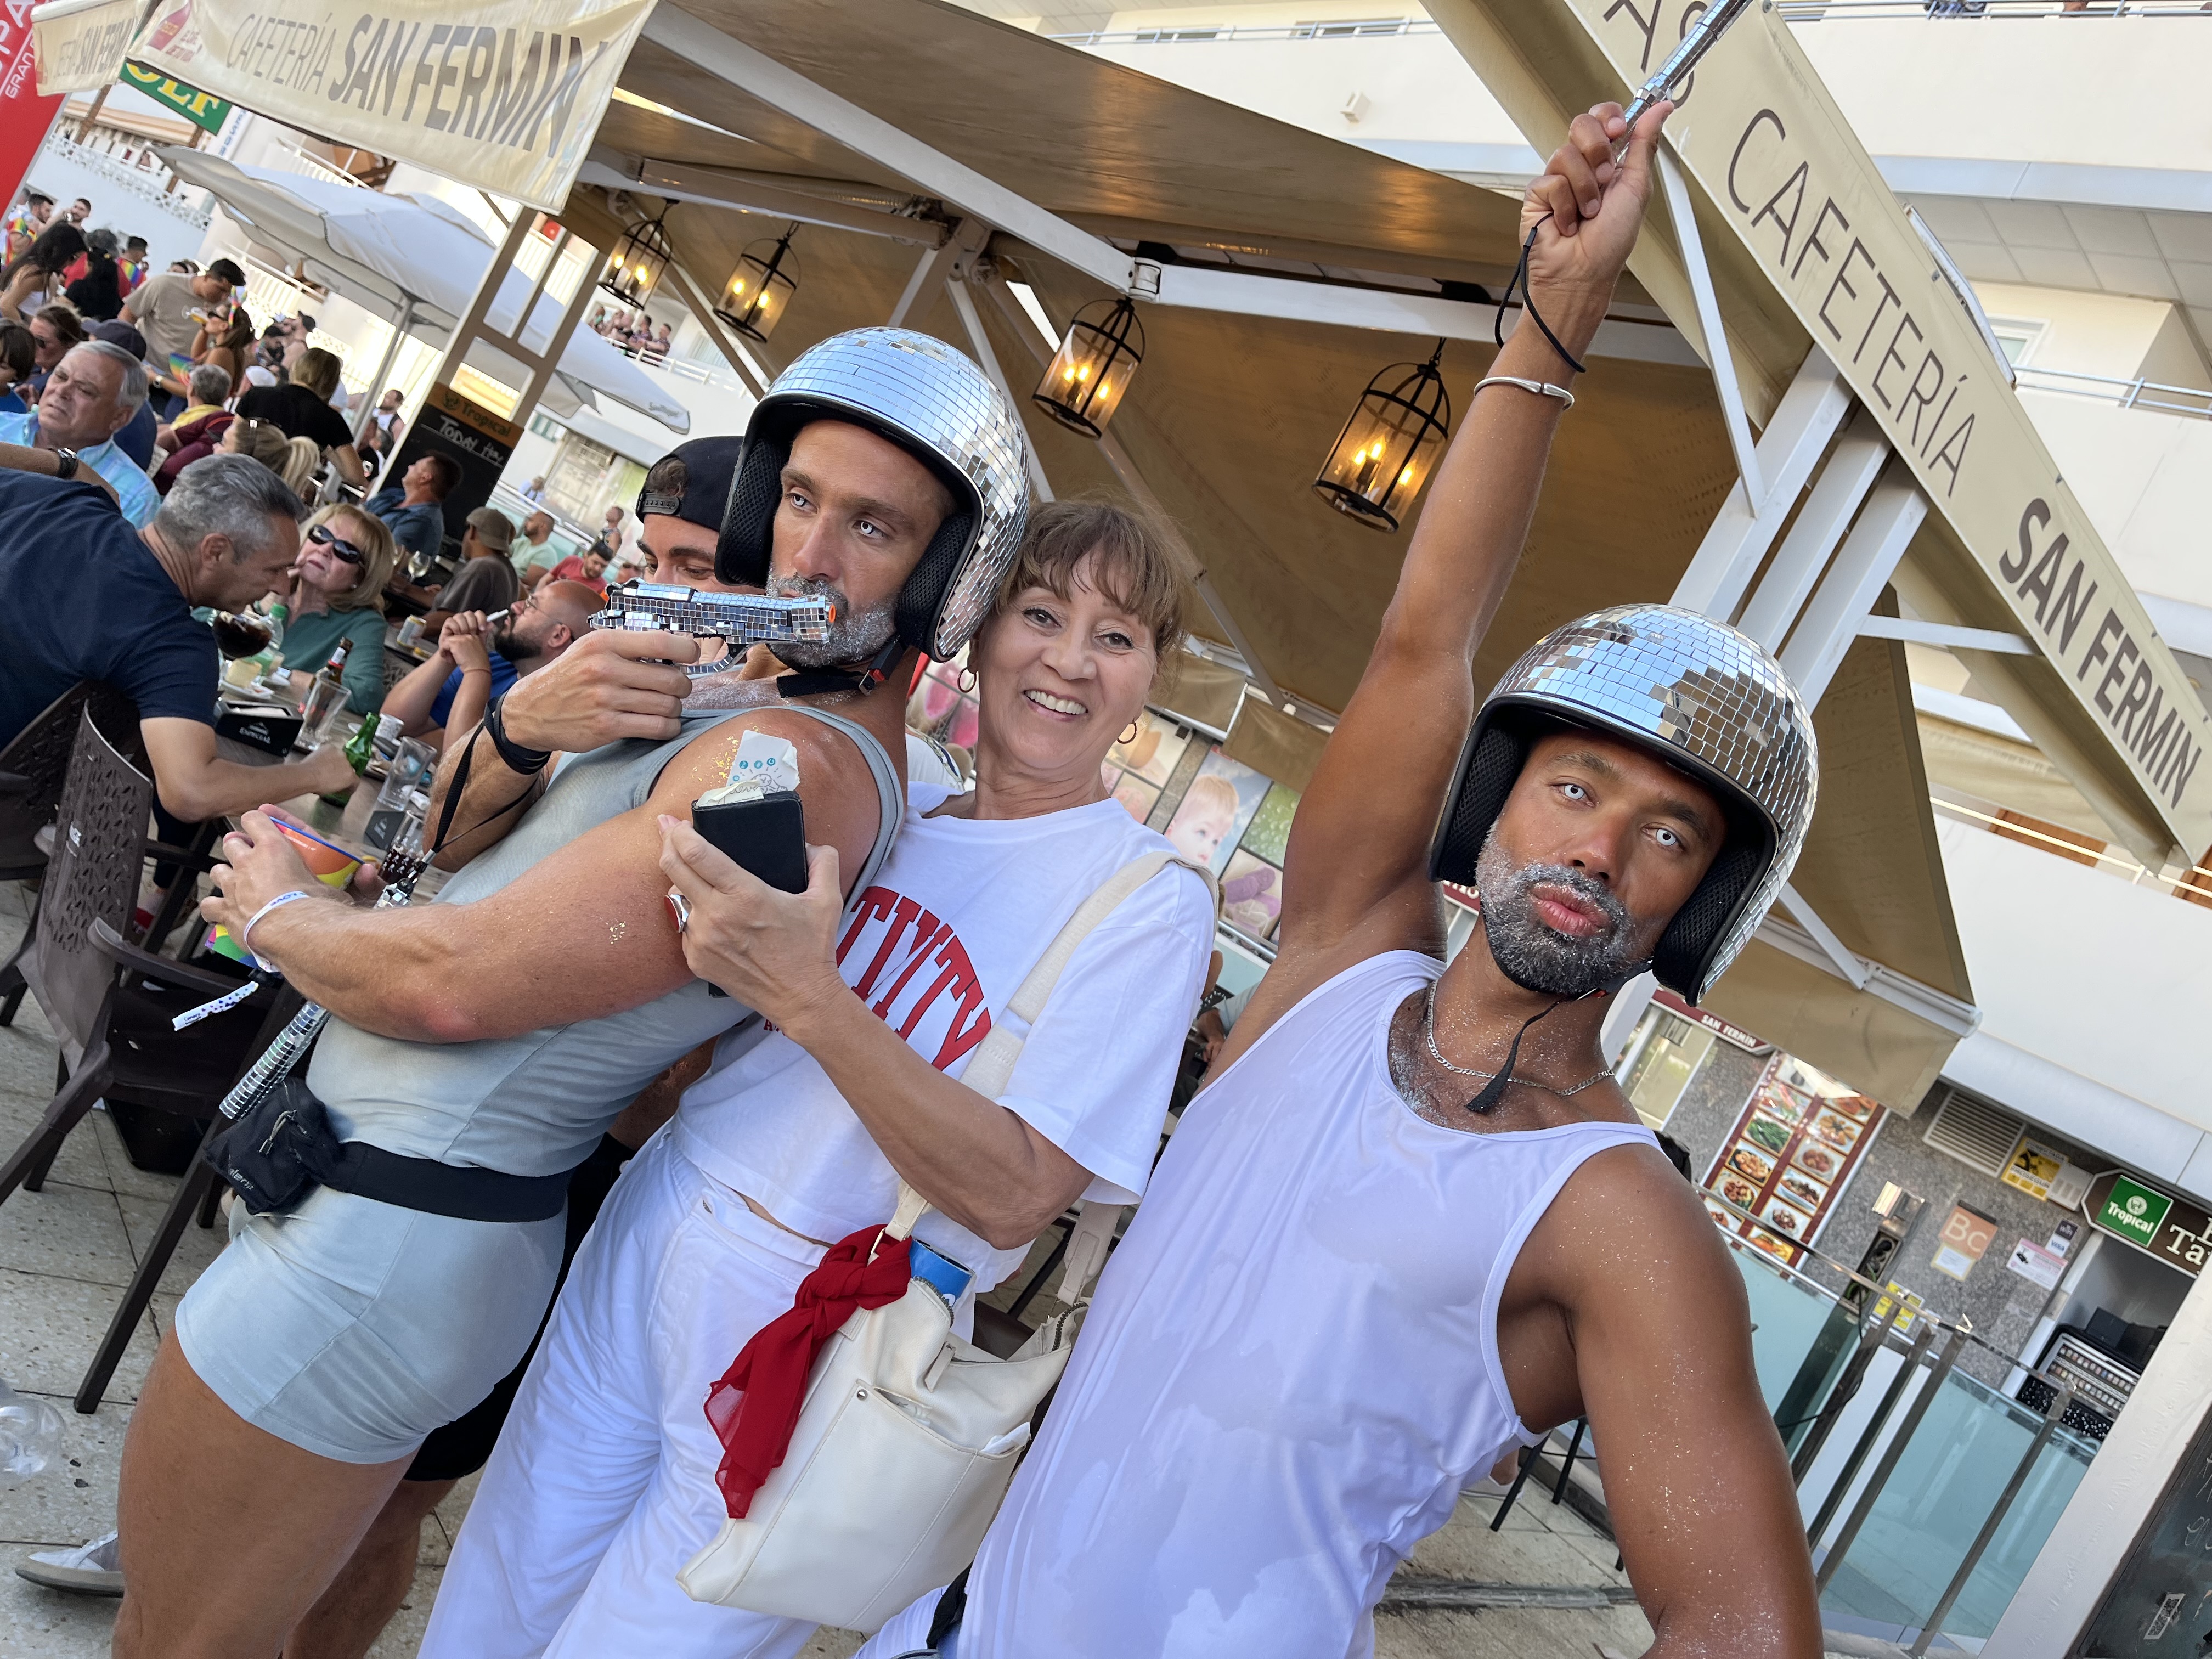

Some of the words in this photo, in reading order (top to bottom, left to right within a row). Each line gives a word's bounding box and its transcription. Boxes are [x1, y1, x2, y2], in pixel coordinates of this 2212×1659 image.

[5, 52, 35, 99] GRAN
[225, 12, 336, 95] CAFETERÍA
[328, 14, 421, 116] SAN
[464, 402, 512, 437] Tropical
[1728, 109, 1976, 498] CAFETERÍA
[1999, 498, 2097, 657] SAN
[2076, 606, 2202, 810] FERMIN
[1701, 1014, 1722, 1031] SAN
[2010, 1165, 2050, 1189] PROSEGUR
[2107, 1201, 2155, 1234] Tropical
